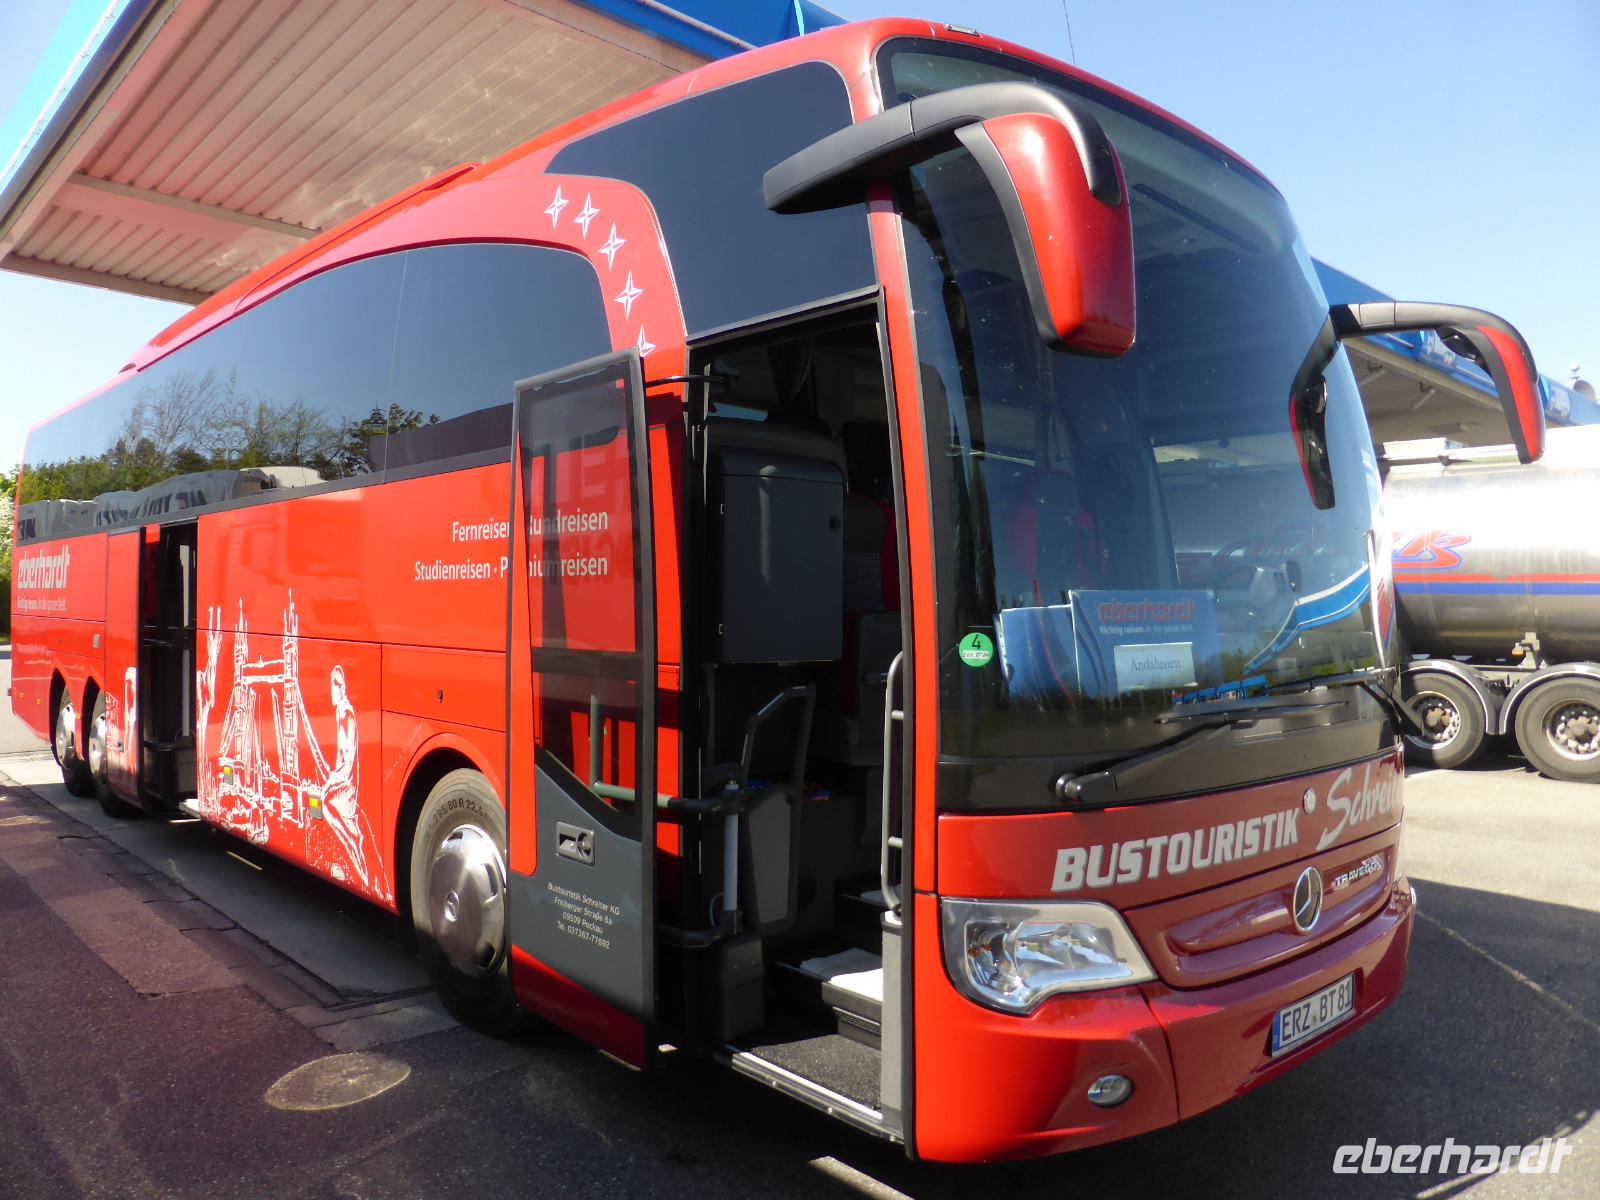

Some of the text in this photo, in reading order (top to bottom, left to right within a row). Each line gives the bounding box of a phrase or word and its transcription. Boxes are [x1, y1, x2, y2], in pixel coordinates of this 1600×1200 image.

[415, 558, 491, 581] Studienreisen
[971, 633, 982, 649] 4
[1130, 656, 1180, 672] Andalusien
[1051, 808, 1300, 892] BUSTOURISTIK
[548, 882, 620, 916] Bustouristik Schreiter KG
[1282, 1002, 1311, 1041] ERZ
[1320, 989, 1337, 1022] BT
[1337, 979, 1351, 1011] 81
